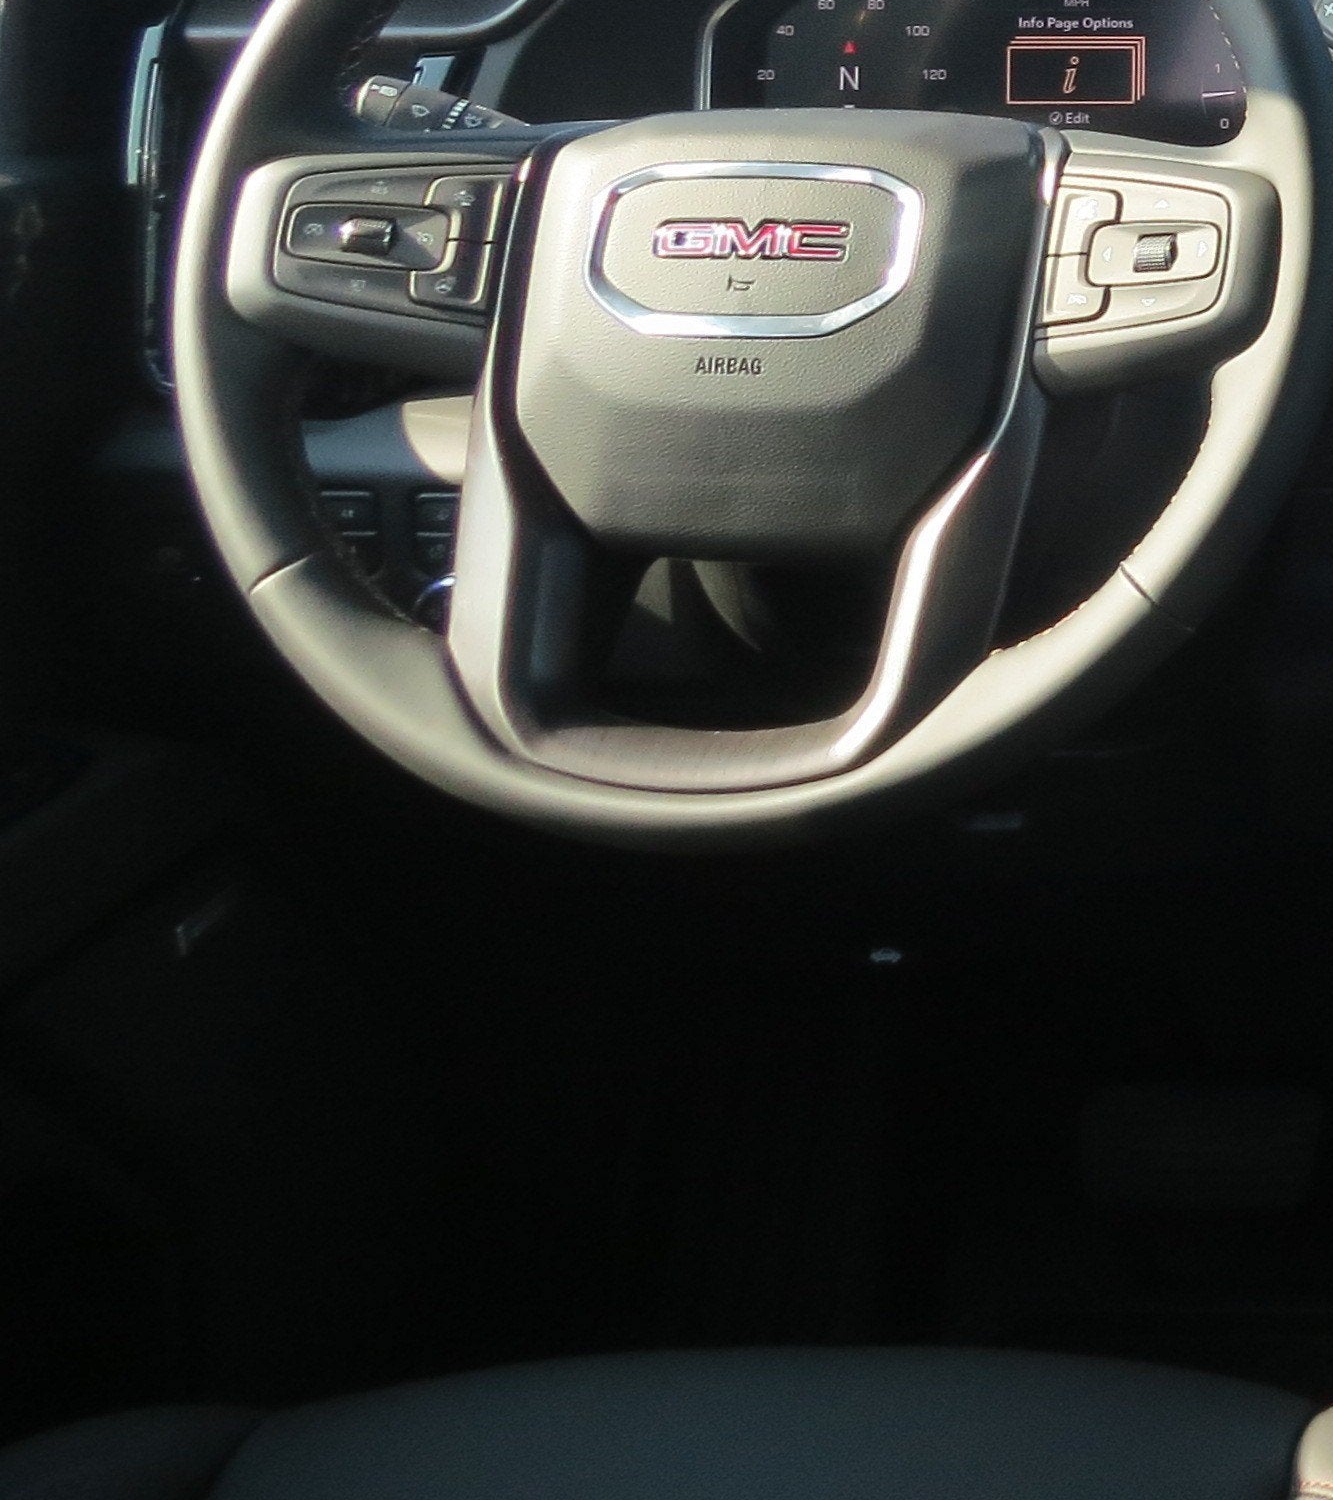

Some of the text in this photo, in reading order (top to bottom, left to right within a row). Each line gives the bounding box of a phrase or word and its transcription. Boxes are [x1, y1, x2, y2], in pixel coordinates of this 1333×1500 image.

[817, 0, 836, 11] 60
[866, 0, 885, 11] 80
[1018, 16, 1134, 32] Info Page Options
[775, 25, 795, 37] 40
[904, 25, 931, 37] 100
[756, 69, 775, 81] 20
[839, 66, 860, 91] N
[922, 69, 948, 81] 120
[1066, 111, 1090, 126] Edit
[653, 219, 851, 261] GMC
[694, 356, 763, 376] AIRBAG
